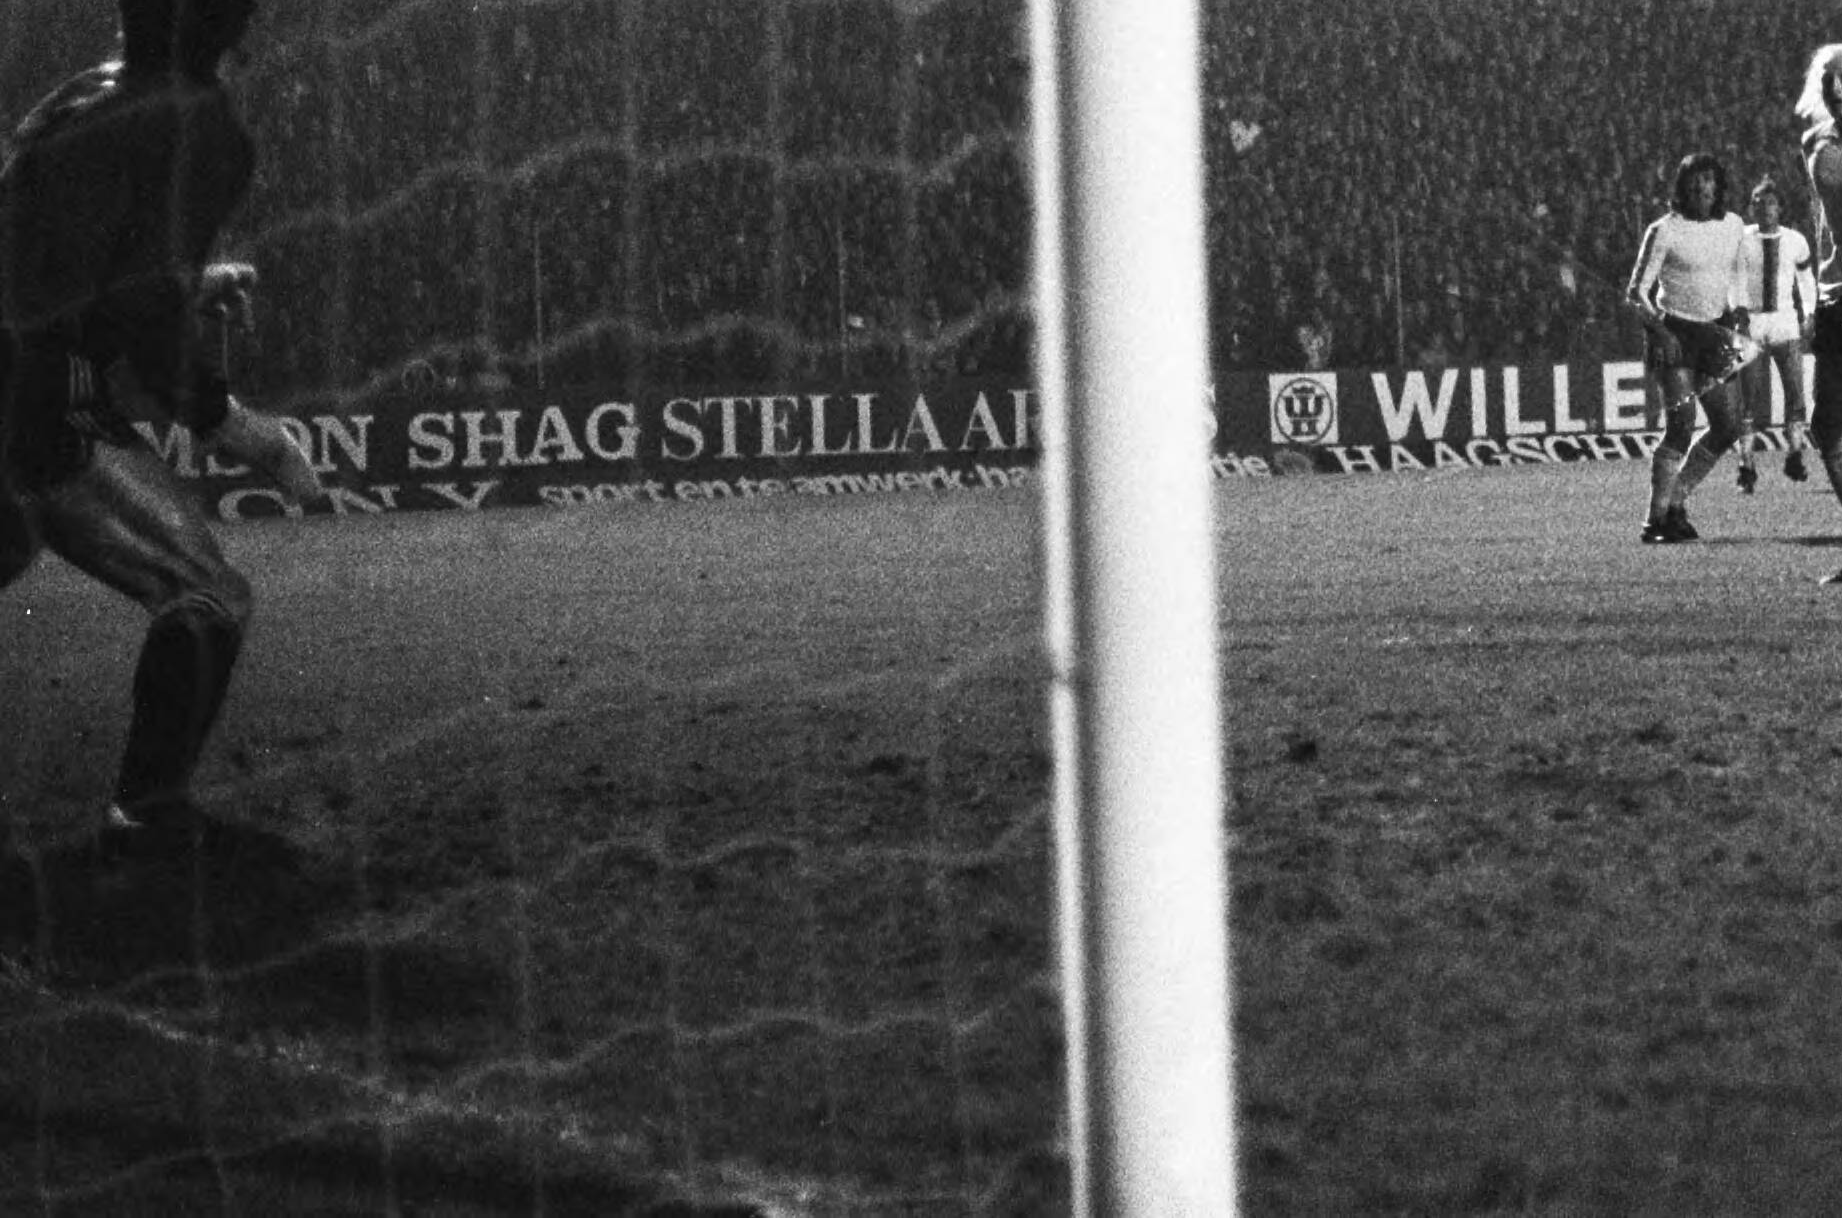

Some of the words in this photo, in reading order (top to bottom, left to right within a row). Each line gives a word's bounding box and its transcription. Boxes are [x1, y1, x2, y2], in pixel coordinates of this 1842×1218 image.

[407, 402, 641, 469] SHAG
[660, 389, 949, 460] STELLA
[1371, 360, 1712, 443] WILLE
